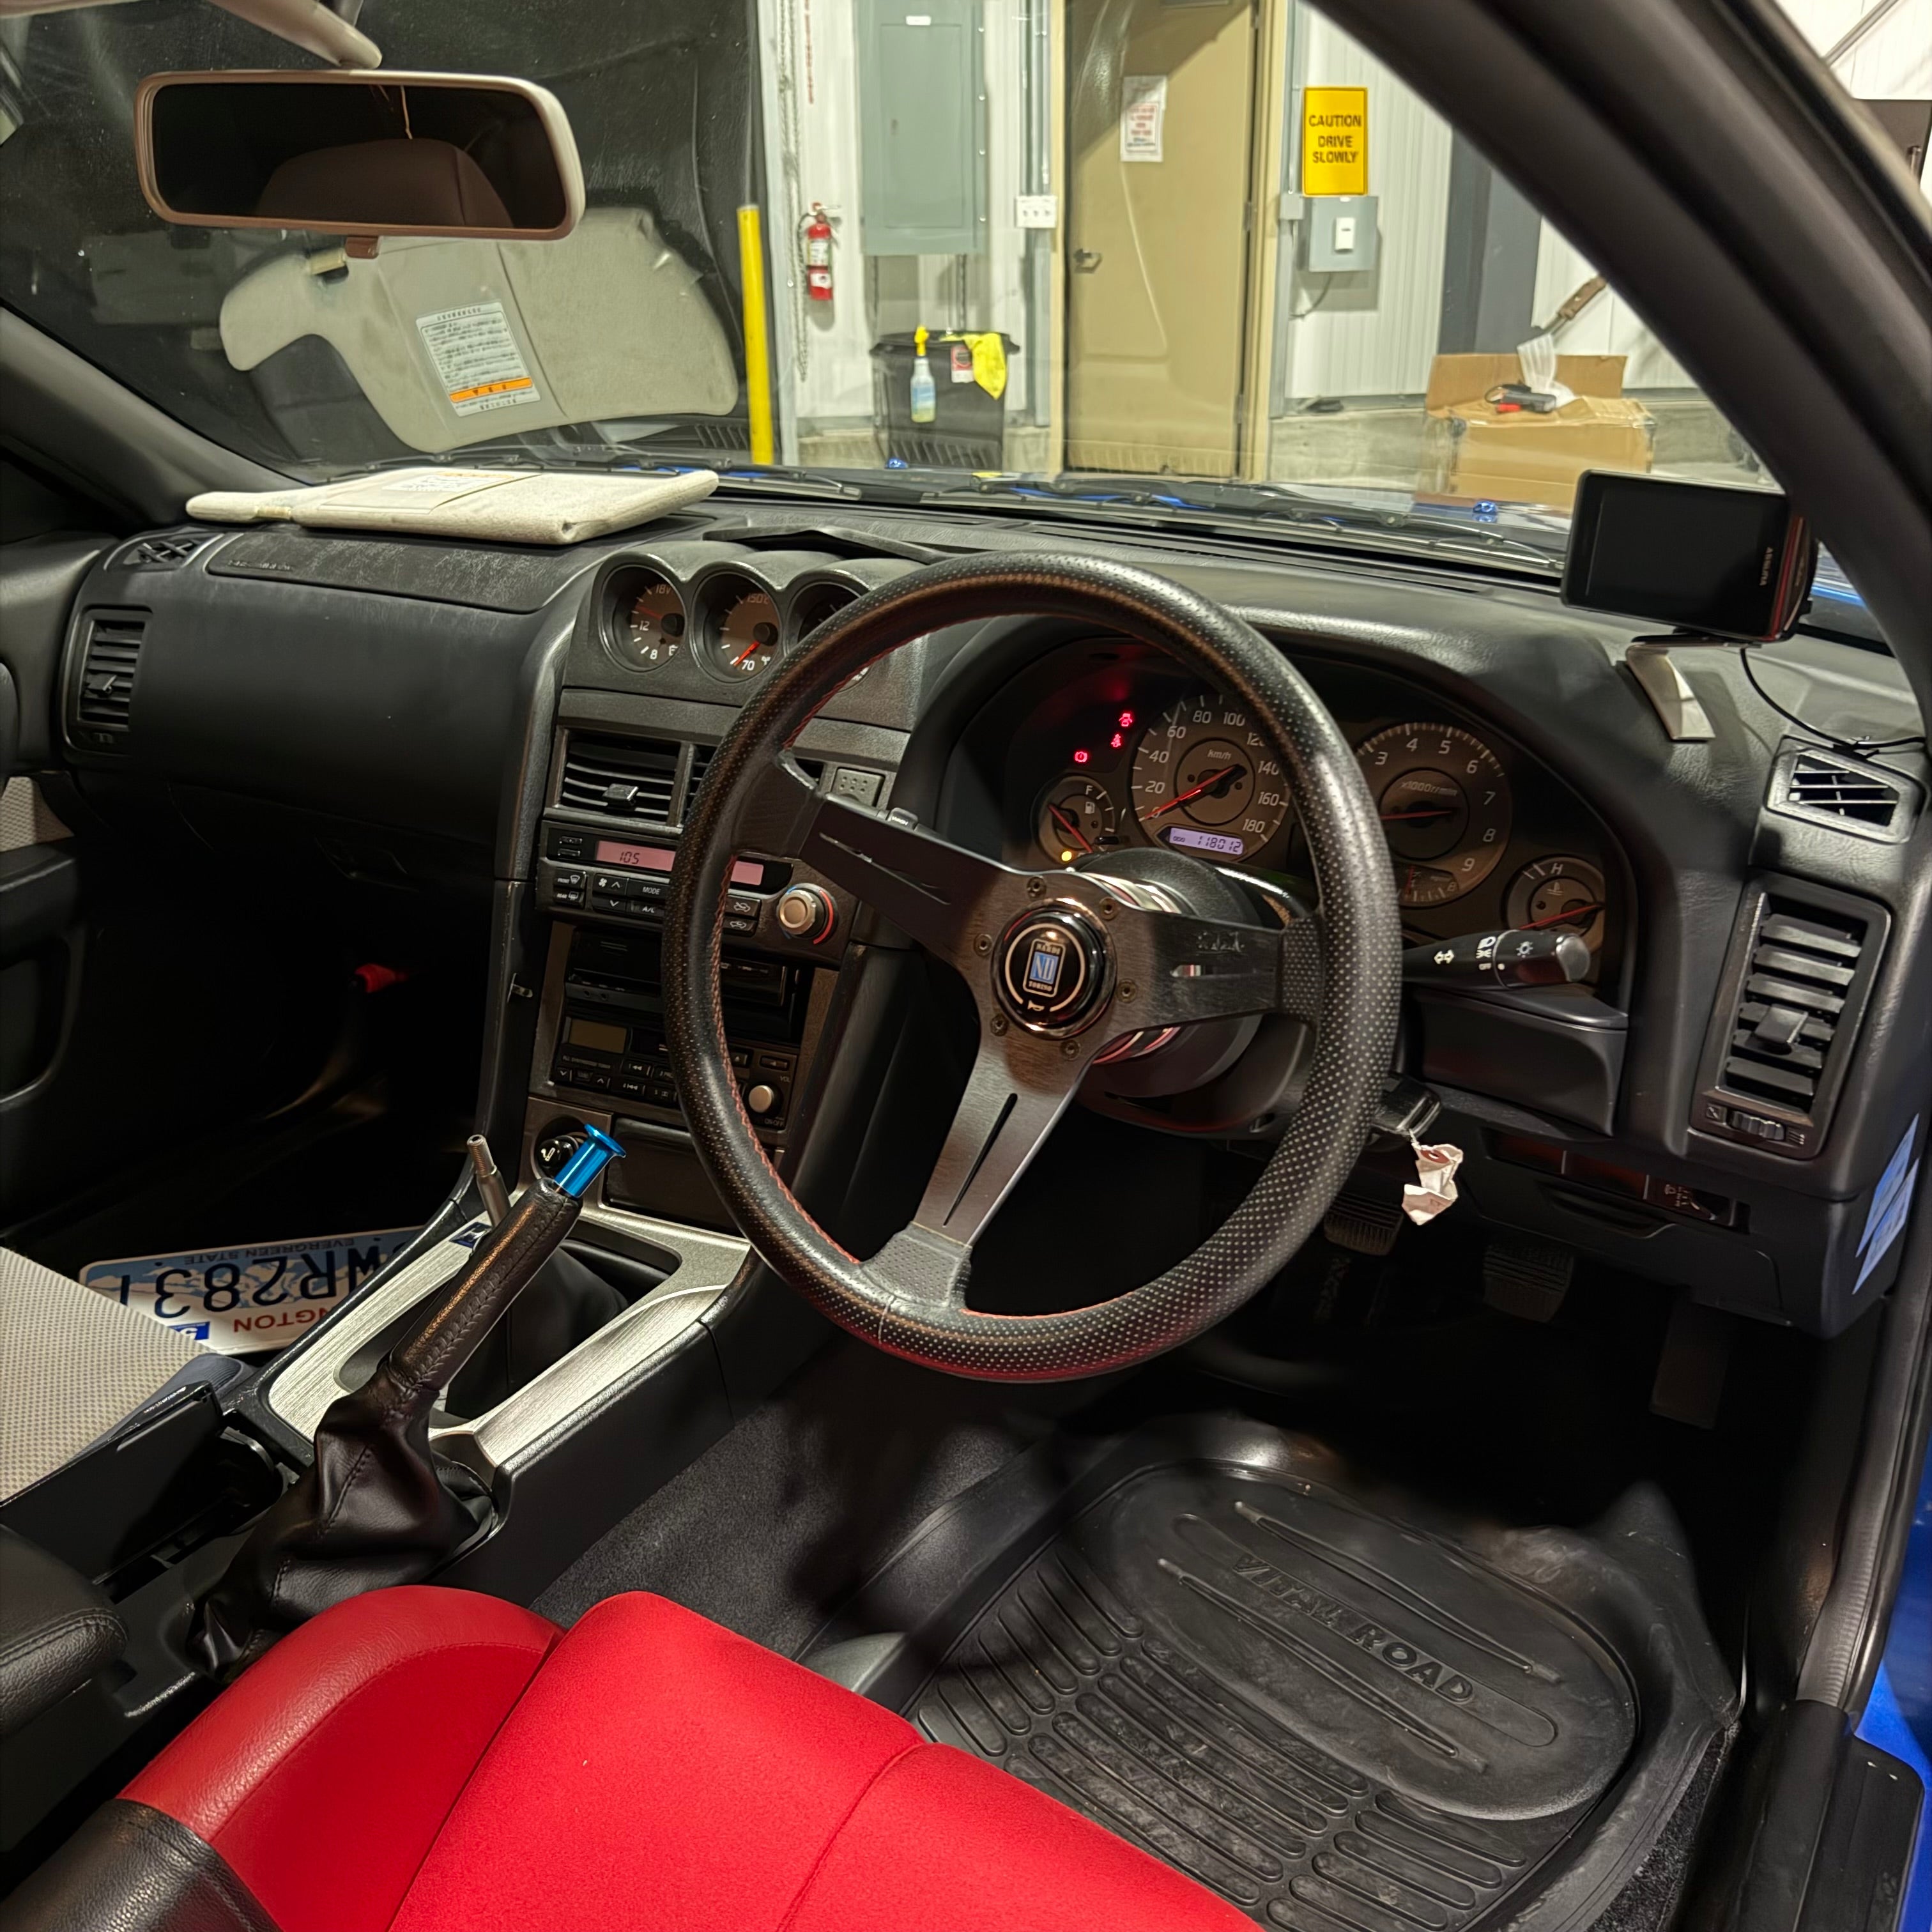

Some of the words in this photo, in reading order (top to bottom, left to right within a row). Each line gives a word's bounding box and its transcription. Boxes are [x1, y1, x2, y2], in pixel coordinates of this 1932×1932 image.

[1308, 114, 1361, 127] CAUTION
[1318, 135, 1353, 148] DRIVE
[1312, 151, 1359, 164] SLOWLY
[640, 620, 650, 631] 12
[650, 649, 658, 660] 8
[742, 659, 755, 671] 70
[1192, 710, 1212, 724] 80
[1223, 711, 1245, 726] 100
[1167, 725, 1186, 739] 60
[1246, 732, 1266, 746] 12
[1406, 738, 1418, 752] 4
[1438, 740, 1452, 755] 5
[1149, 749, 1169, 763] 40
[1207, 749, 1232, 760] km/h
[1375, 751, 1388, 765] 3
[1466, 759, 1478, 774] 6
[1085, 786, 1092, 795] F
[1145, 780, 1165, 794] 20
[1257, 791, 1280, 806] 160
[1482, 790, 1496, 805] 7
[1242, 818, 1266, 833] 180
[1482, 828, 1496, 842] 8
[1197, 835, 1242, 853] 118012
[1460, 857, 1475, 871] 9
[1551, 862, 1563, 874] H
[642, 886, 661, 895] MODE
[245, 1238, 355, 1257] EVERGREEN
[183, 1250, 238, 1266] STATE
[120, 1242, 405, 1318] WR2831
[1347, 1621, 1473, 1705] ROAD
